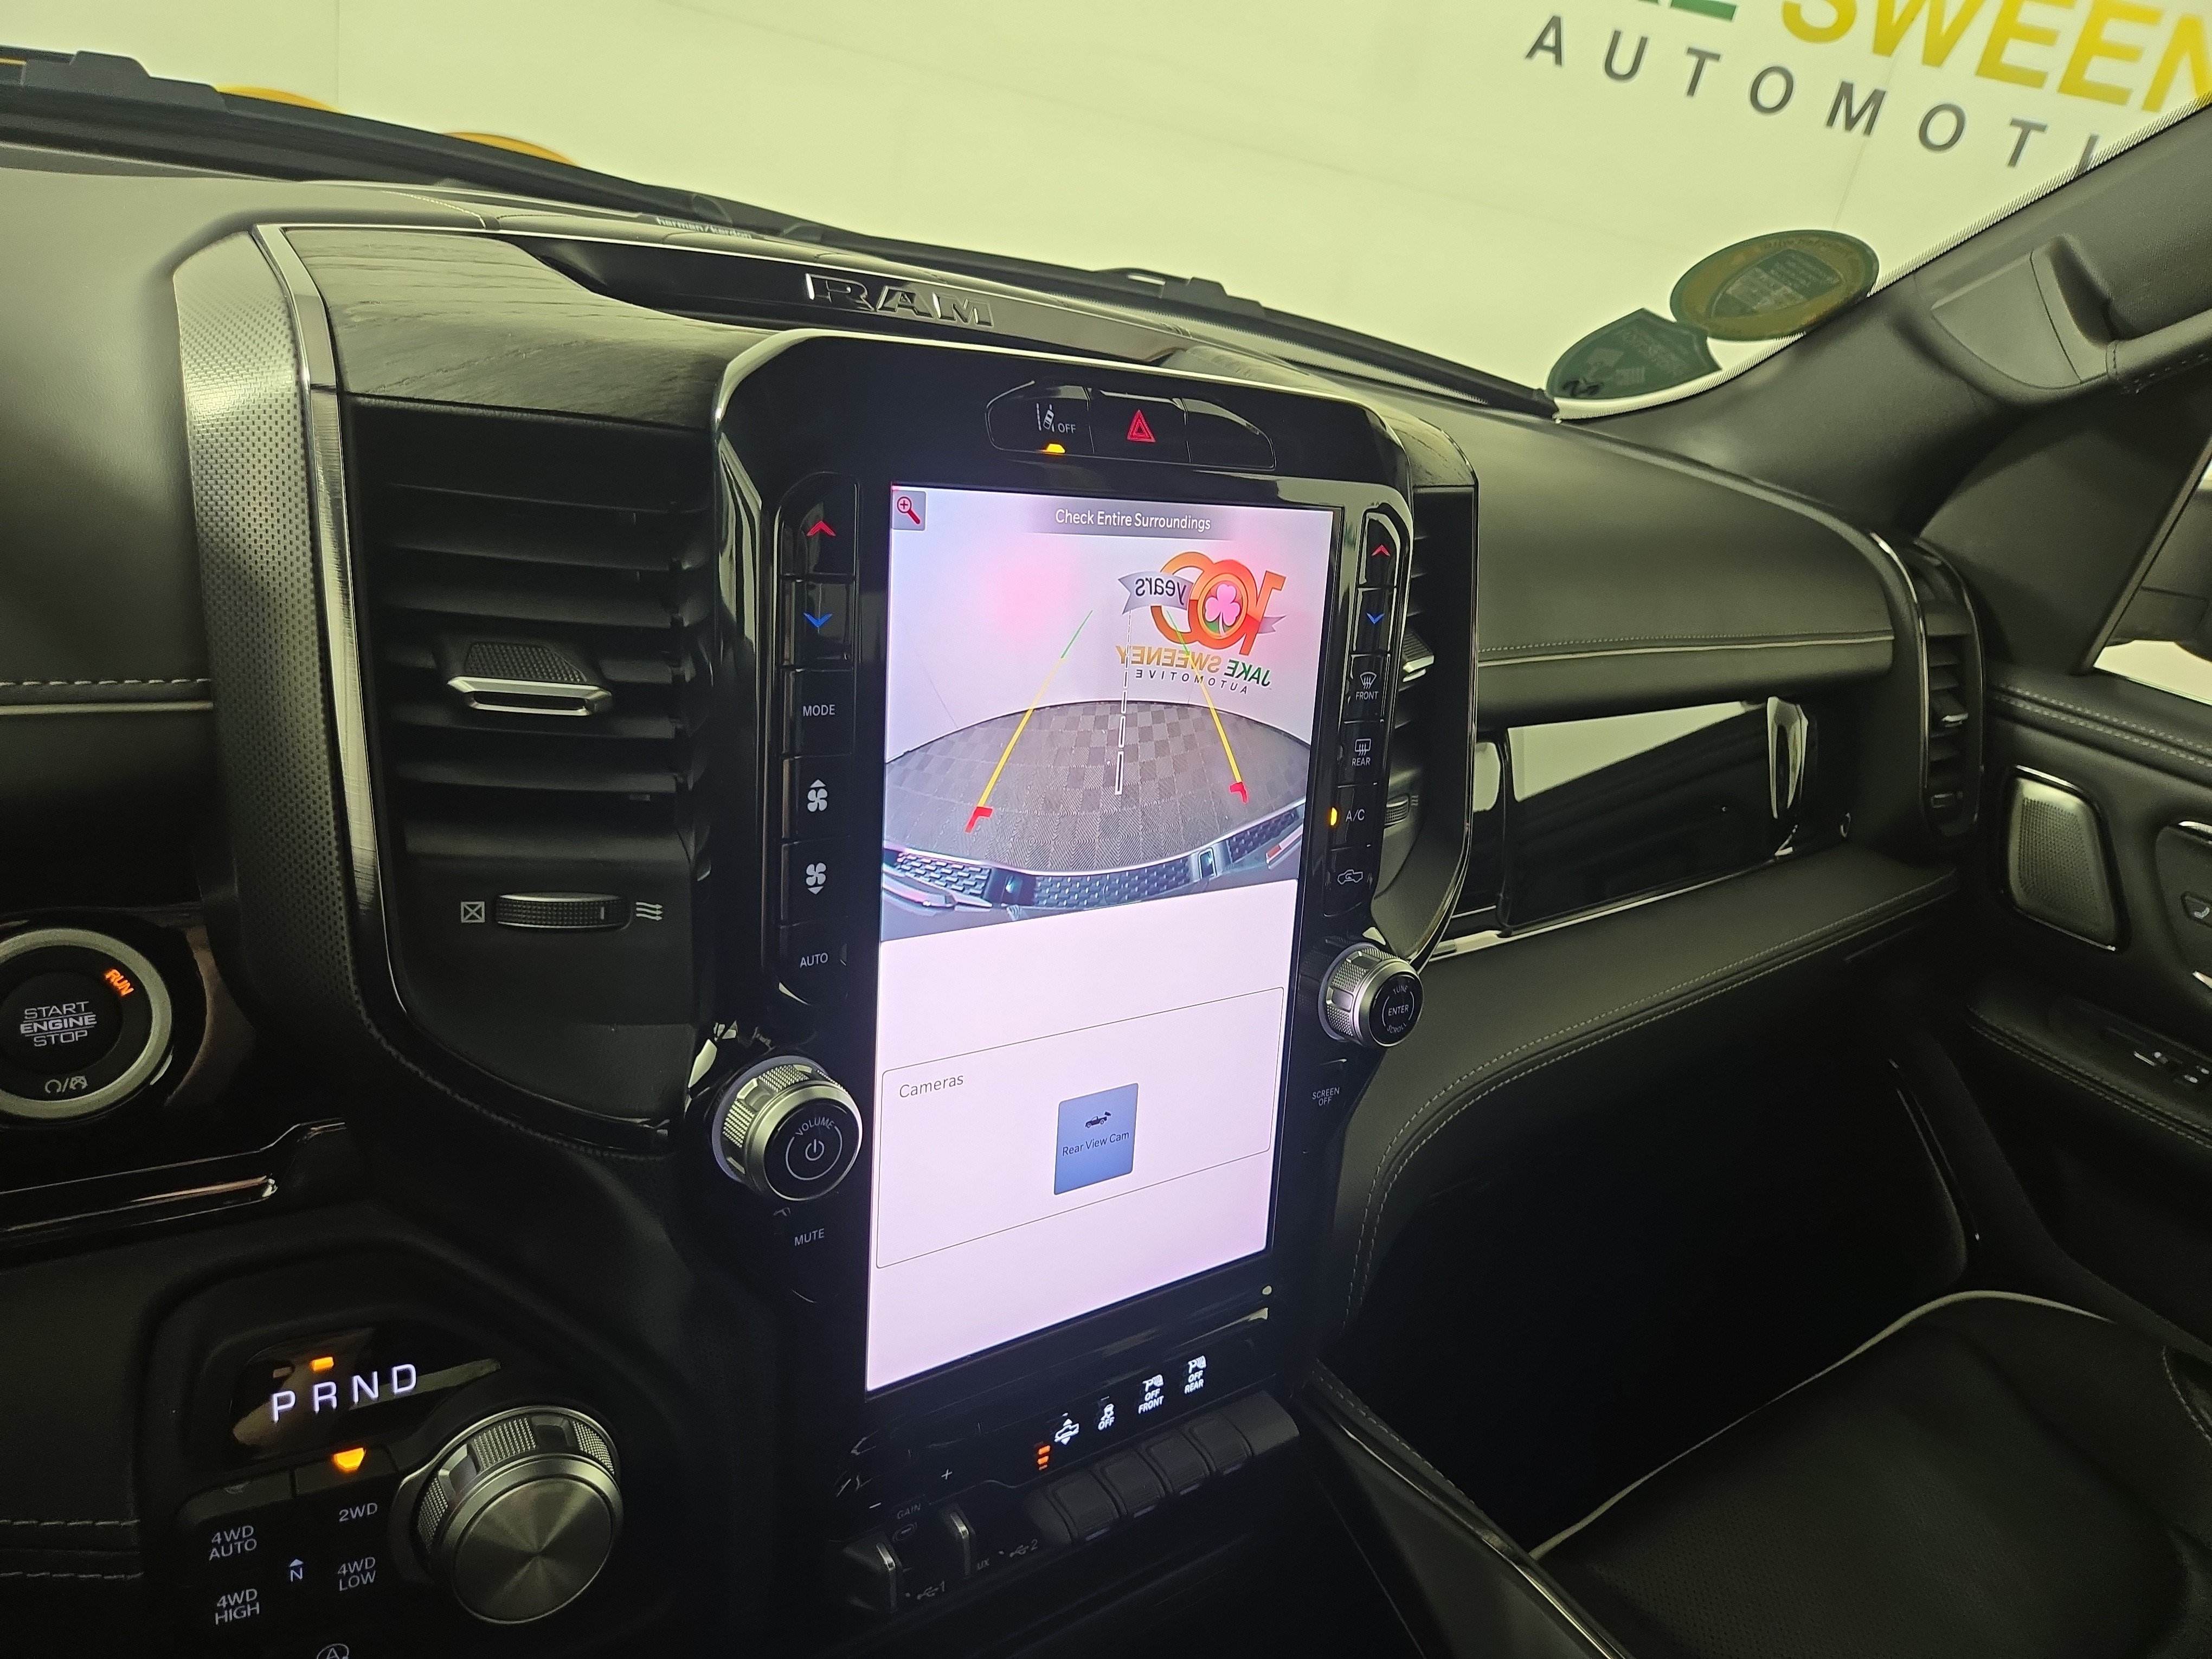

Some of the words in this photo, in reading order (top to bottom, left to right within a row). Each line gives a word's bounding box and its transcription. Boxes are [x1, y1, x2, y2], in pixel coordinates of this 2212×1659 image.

[806, 273, 994, 327] RAM
[1058, 423, 1076, 434] OFF
[1056, 509, 1094, 525] Check
[1097, 511, 1132, 527] Entire
[1134, 513, 1211, 533] Surroundings
[1355, 690, 1379, 700] FRONT
[802, 704, 835, 717] MODE
[1352, 757, 1371, 767] REAR
[1346, 809, 1365, 822] A/C
[800, 953, 828, 969] AUTO
[105, 969, 134, 996] RUN
[24, 1001, 89, 1020] START
[1388, 1004, 1409, 1016] ENTER
[20, 1014, 97, 1034] ENGINE
[33, 1030, 88, 1047] STOP
[899, 1073, 964, 1098] Cameras
[1312, 1086, 1340, 1100] SCREEN
[1319, 1096, 1332, 1106] OFF
[795, 1116, 834, 1136] VOLUME
[1062, 1143, 1084, 1156] Rear
[1085, 1138, 1108, 1150] View
[1109, 1132, 1129, 1143] Cam
[794, 1228, 825, 1246] MUTE
[1188, 1370, 1204, 1382] OFF
[272, 1390, 296, 1423] P
[313, 1381, 337, 1413] R
[352, 1371, 379, 1404] N
[392, 1364, 416, 1394] D
[1144, 1388, 1161, 1401] OFF
[1184, 1379, 1204, 1394] REAR
[1138, 1396, 1165, 1414] FRONT
[1098, 1417, 1115, 1431] OFF
[338, 1502, 378, 1523] 2WD
[896, 1504, 921, 1520] GAIN
[211, 1525, 254, 1544] 4WD
[209, 1538, 257, 1561] AUTO
[290, 1567, 304, 1583] N
[337, 1557, 376, 1576] 4WD
[338, 1570, 376, 1591] LOW
[217, 1589, 258, 1609] 4WD
[215, 1602, 260, 1625] HIGH
